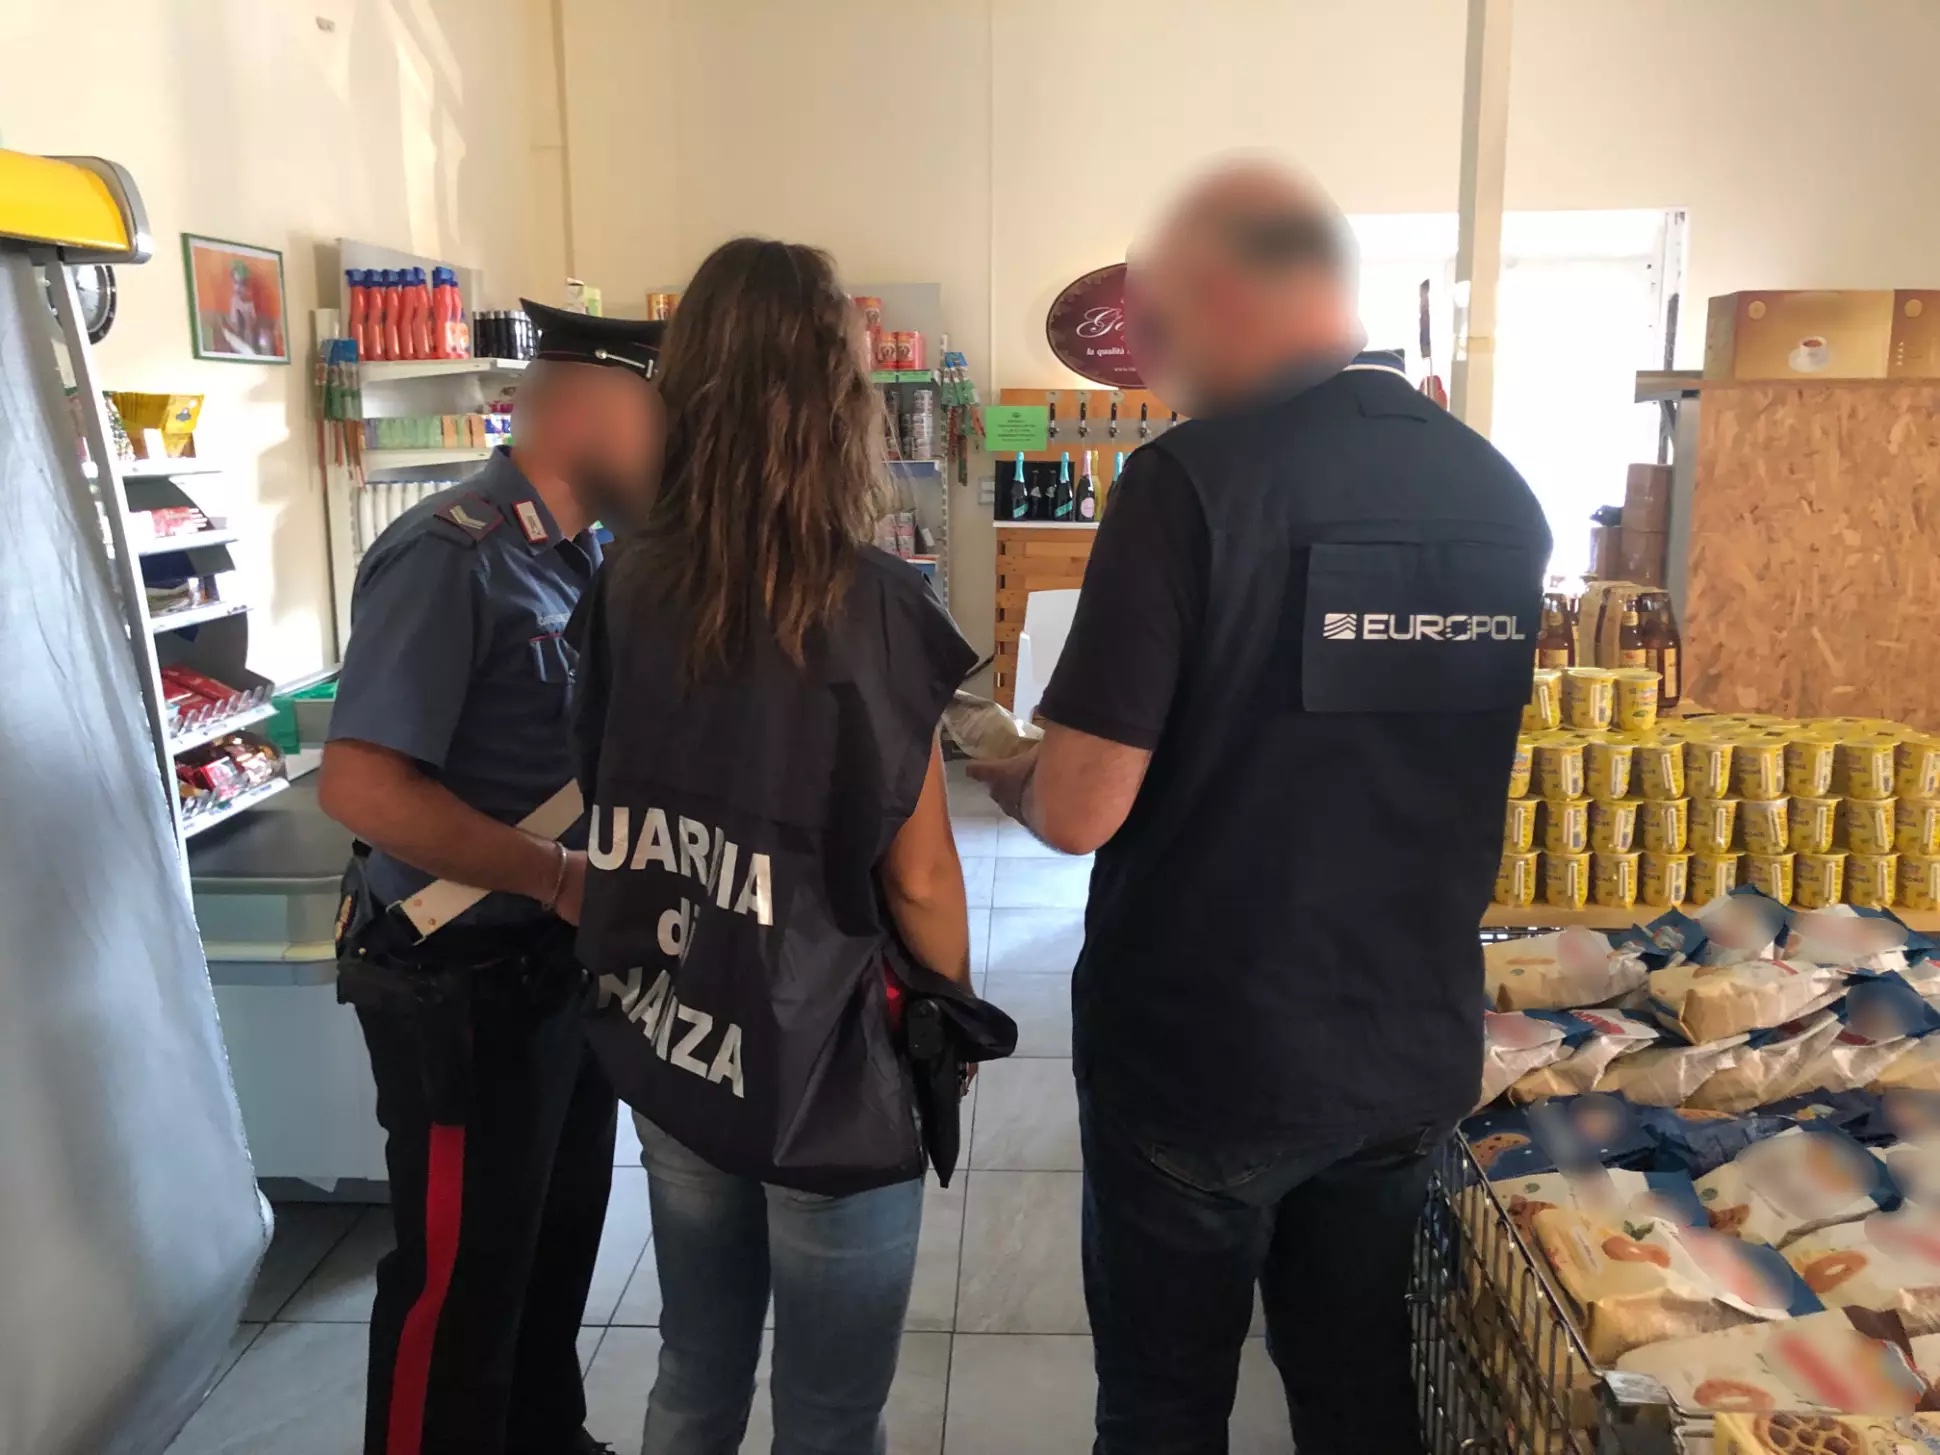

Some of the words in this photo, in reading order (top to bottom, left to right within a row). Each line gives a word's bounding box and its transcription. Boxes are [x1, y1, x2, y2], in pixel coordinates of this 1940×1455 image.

[1096, 346, 1125, 357] qualità
[1362, 614, 1526, 640] EUROPOL
[588, 804, 774, 926] UARIA
[657, 897, 700, 968] di
[596, 966, 745, 1098] NAZA
